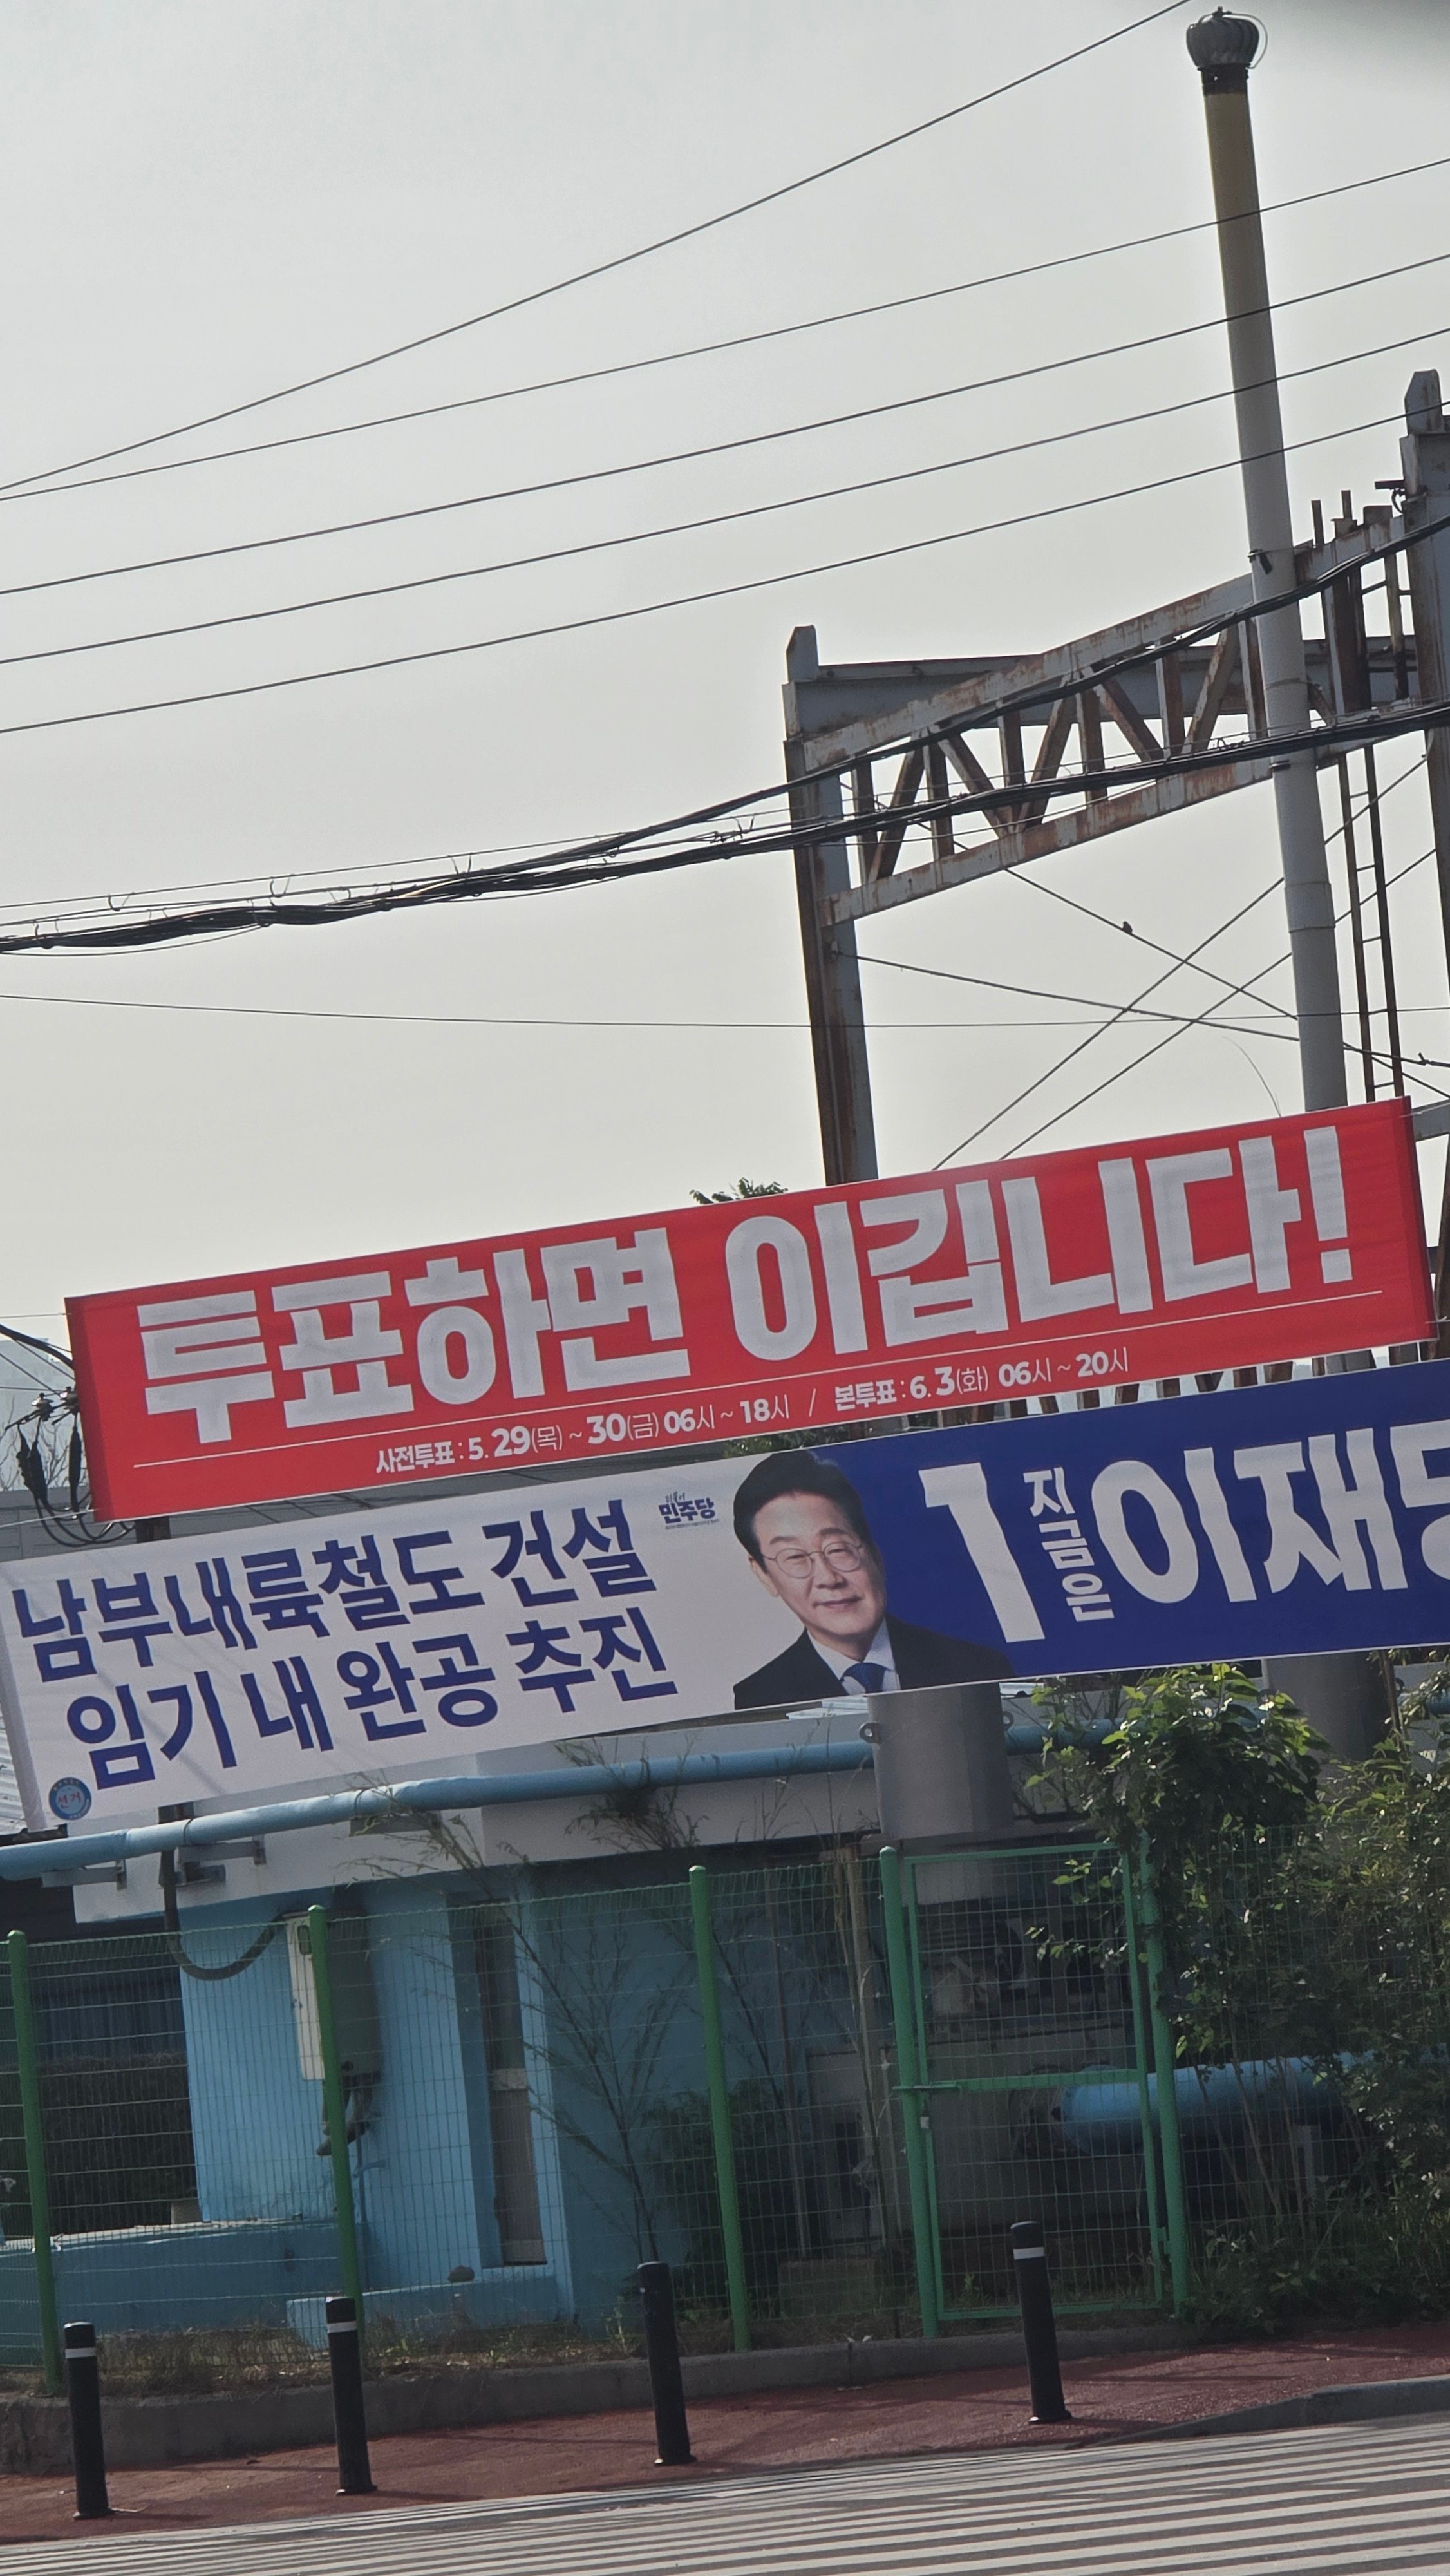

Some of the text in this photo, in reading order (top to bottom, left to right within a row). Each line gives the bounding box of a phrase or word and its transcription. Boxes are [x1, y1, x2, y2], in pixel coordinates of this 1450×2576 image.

[137, 1126, 1353, 1444] 투표하면 이깁니다!
[376, 1441, 455, 1474] 사전투표
[740, 1394, 789, 1423] 18시
[834, 1379, 898, 1412] 본투표
[998, 1358, 1051, 1387] 06시
[1075, 1346, 1128, 1378] 20시
[13, 1499, 656, 1682] 남부내륙철도 건설
[658, 1497, 715, 1524] 민주당
[918, 1462, 1046, 1643] 1
[1022, 1466, 1115, 1622] 지금은
[67, 1607, 678, 1790] 임기 내 완공 추진
